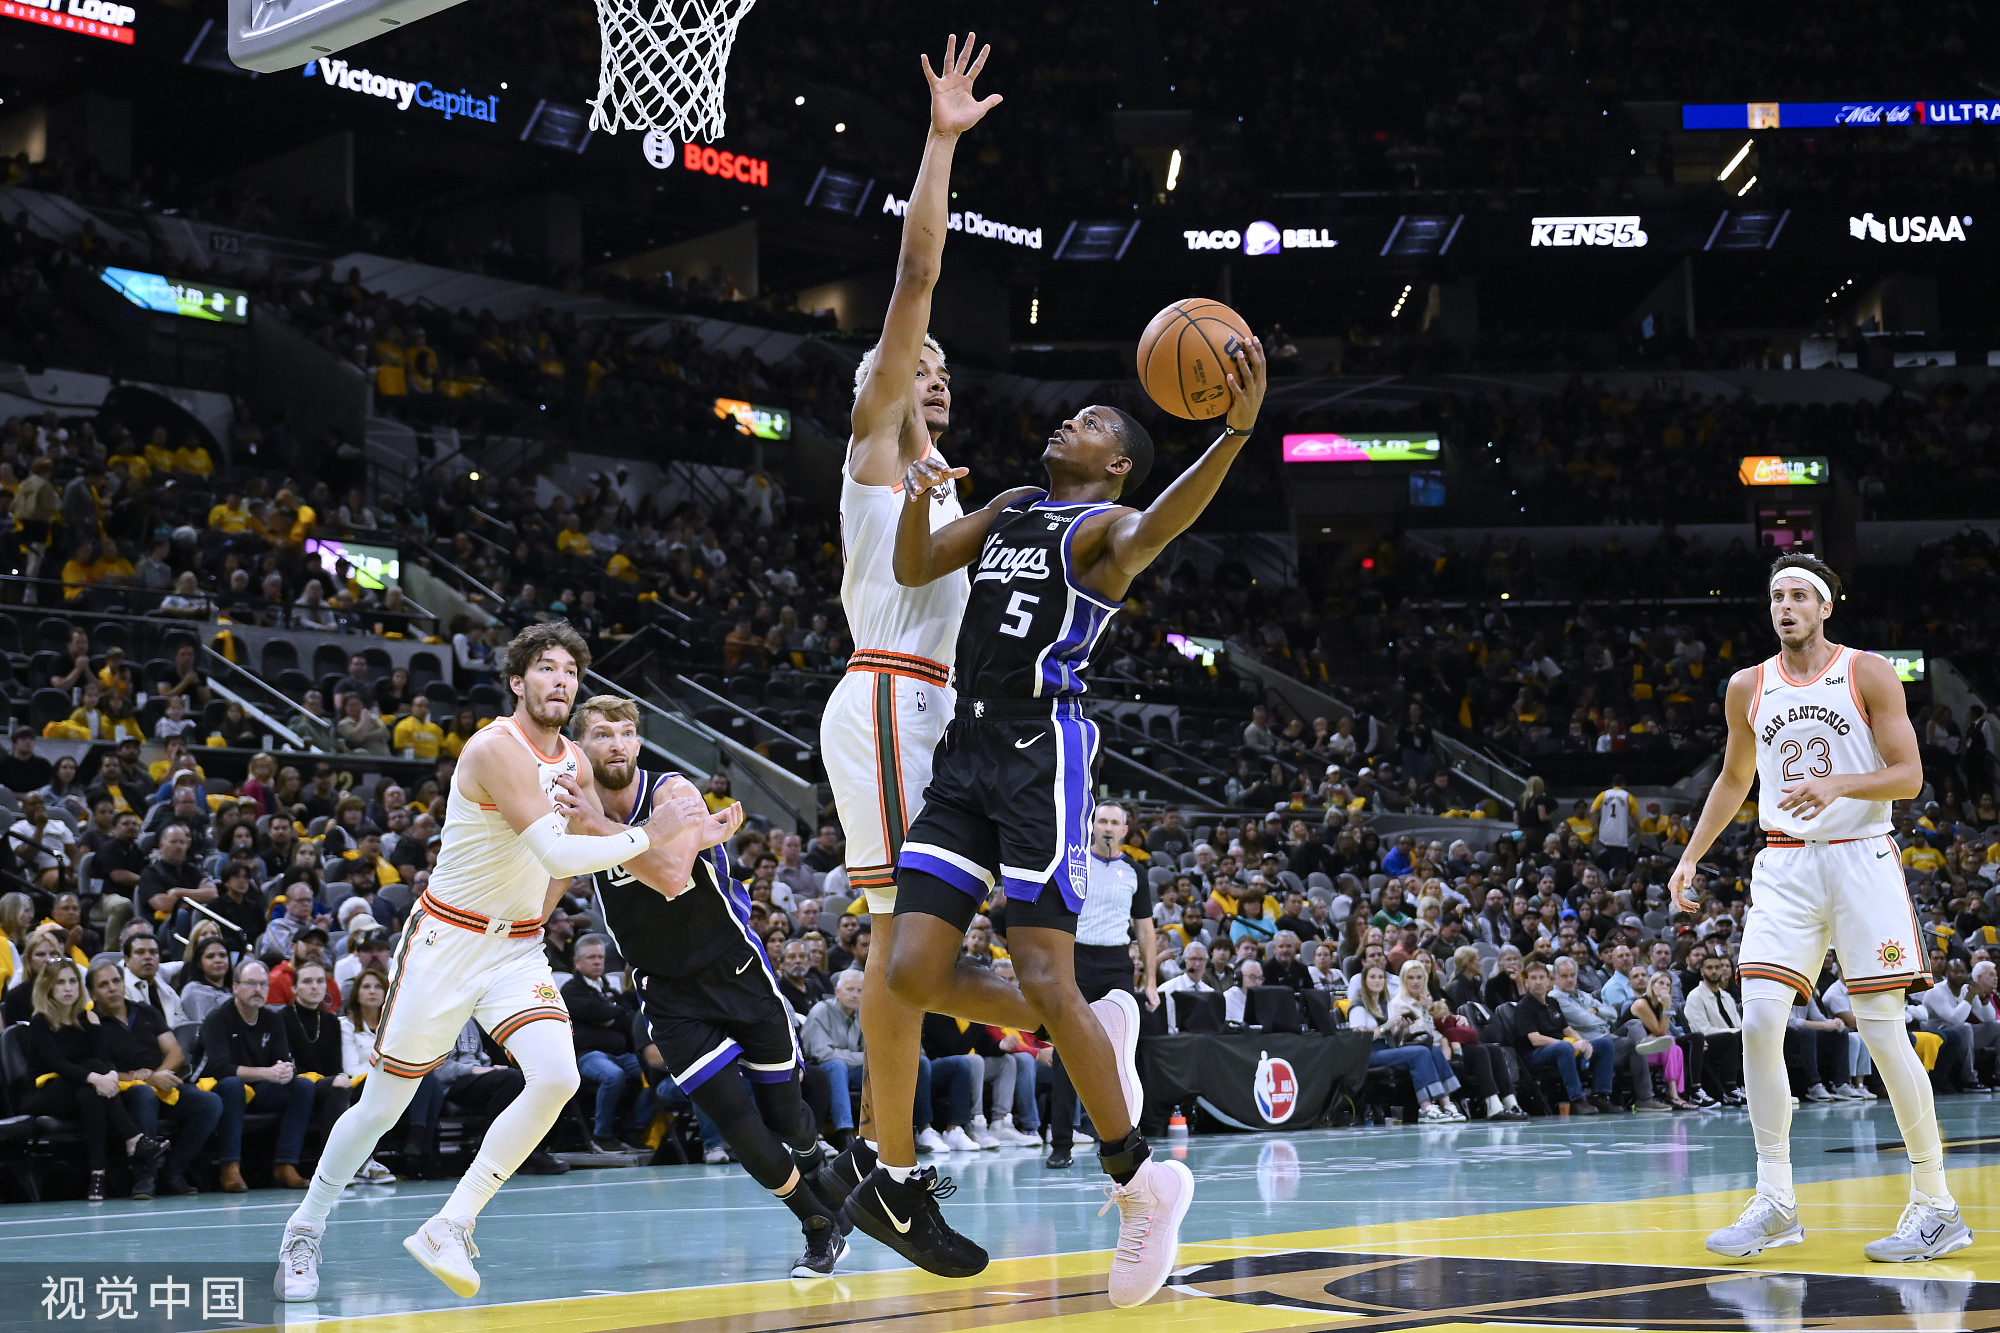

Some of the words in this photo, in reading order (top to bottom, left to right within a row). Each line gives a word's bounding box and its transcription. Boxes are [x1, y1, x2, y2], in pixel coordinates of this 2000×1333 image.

[4, 3, 119, 38] MITSUBISHI
[684, 142, 769, 187] BOSCH
[964, 210, 1043, 249] Diamond
[1183, 229, 1241, 250] TACO
[1282, 228, 1336, 248] BELL
[1888, 216, 1967, 243] USAA
[1043, 512, 1075, 523] dialpad
[999, 590, 1040, 638] 5
[1761, 714, 1786, 747] SAN
[1788, 705, 1851, 737] ANTONIO
[1780, 737, 1833, 782] 23
[1272, 1093, 1293, 1103] ESPN
